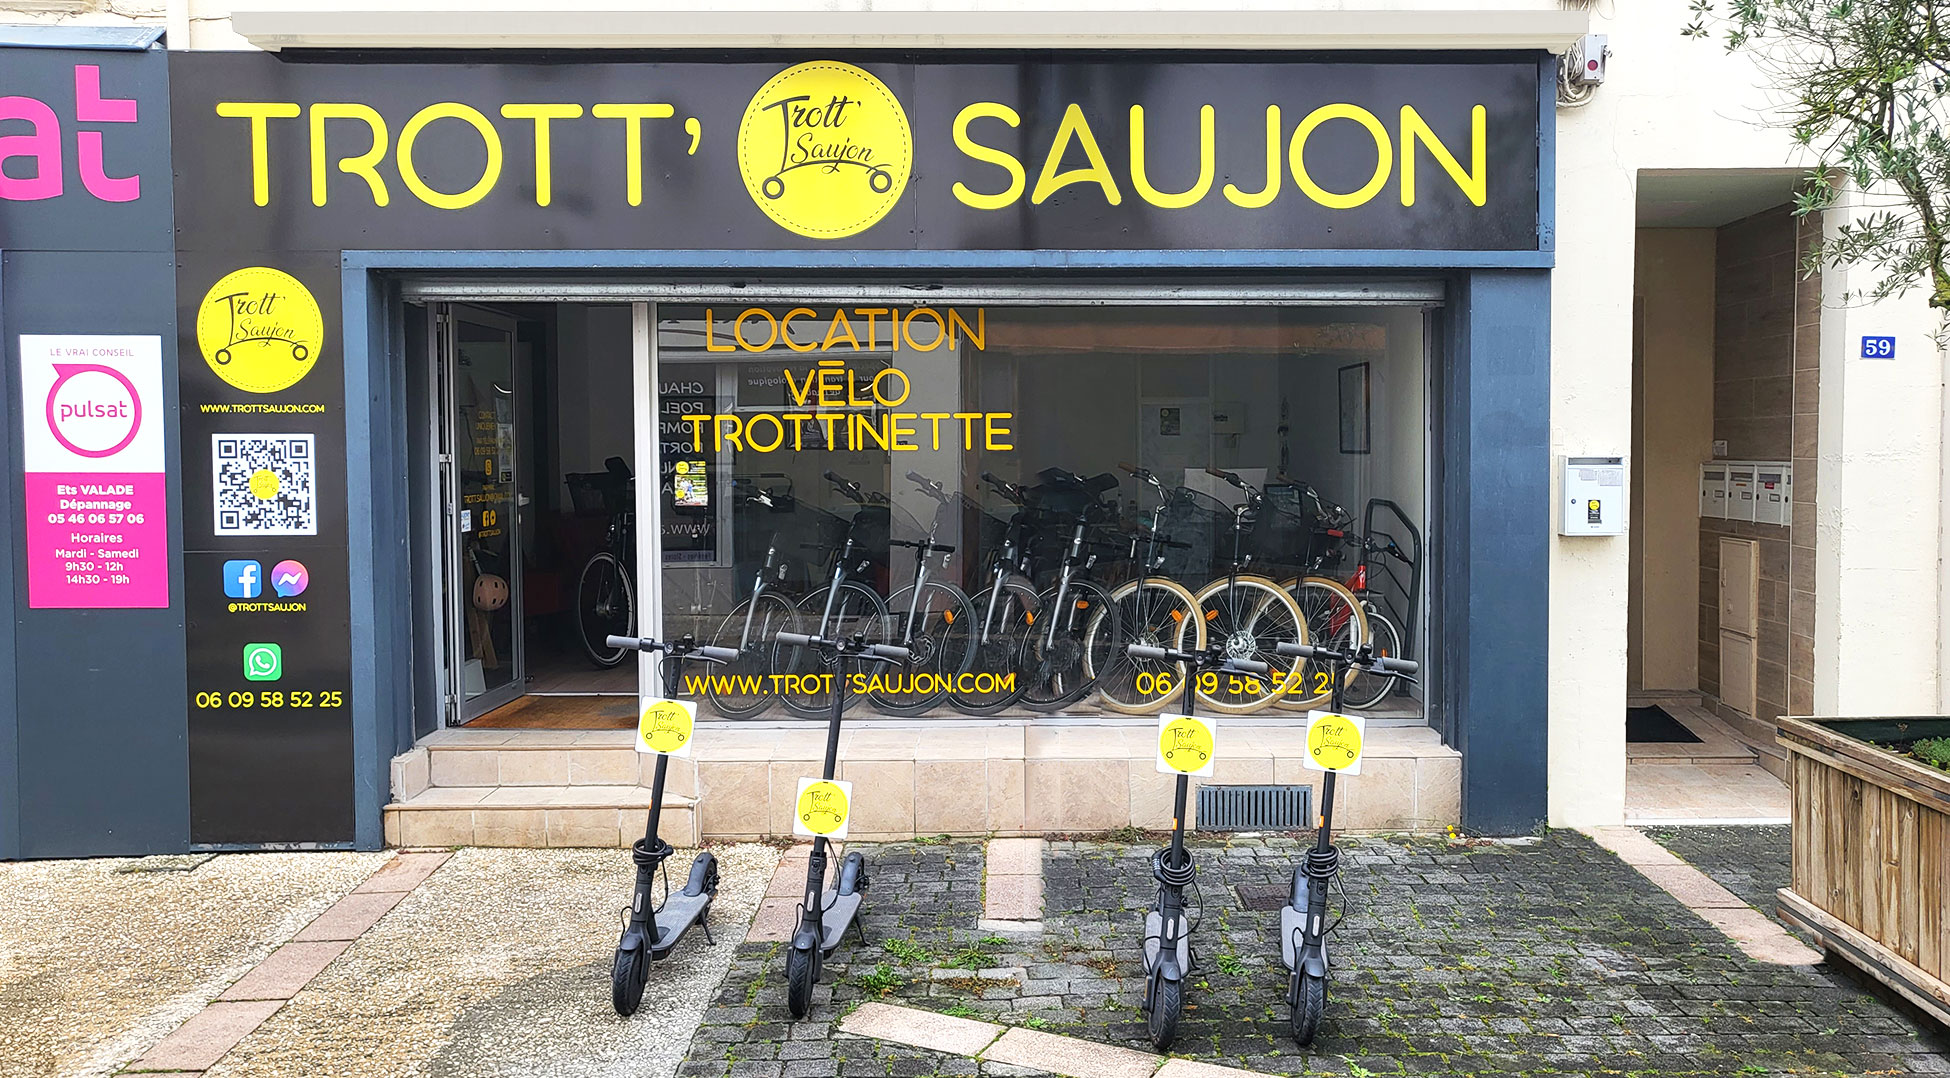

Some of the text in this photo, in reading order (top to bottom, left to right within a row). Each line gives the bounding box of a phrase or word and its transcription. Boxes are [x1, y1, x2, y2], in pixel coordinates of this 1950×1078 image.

[790, 132, 875, 175] Saujon
[951, 102, 1486, 209] SAUJON
[235, 317, 297, 348] Saujon
[706, 308, 986, 352] LOCATION
[49, 348, 135, 357] LE VRAI CONSEIL
[1865, 339, 1891, 356] 59
[60, 400, 128, 422] pulsat
[200, 404, 325, 414] WWW.TROTTSAUJON.COM
[681, 412, 1014, 452] TROTTINETTE
[57, 485, 134, 495] Ets VALADE
[60, 498, 132, 511] Dépannage
[48, 513, 145, 524] 05 46 06 57 06
[71, 532, 123, 543] Horaires
[55, 548, 87, 558] Mardi
[97, 548, 139, 558] Samedi
[65, 561, 95, 571] 9h30
[105, 561, 124, 571] 12h
[66, 574, 100, 584] 14h30
[110, 574, 130, 584] 19h
[228, 603, 307, 613] @TROTTSAUJON
[684, 674, 1016, 695] WWW.TROTSAUJON.COM
[1136, 672, 1172, 695] 06
[1271, 672, 1303, 694] 52
[1313, 672, 1335, 694] 2
[196, 691, 343, 708] 06 09 58 52 25
